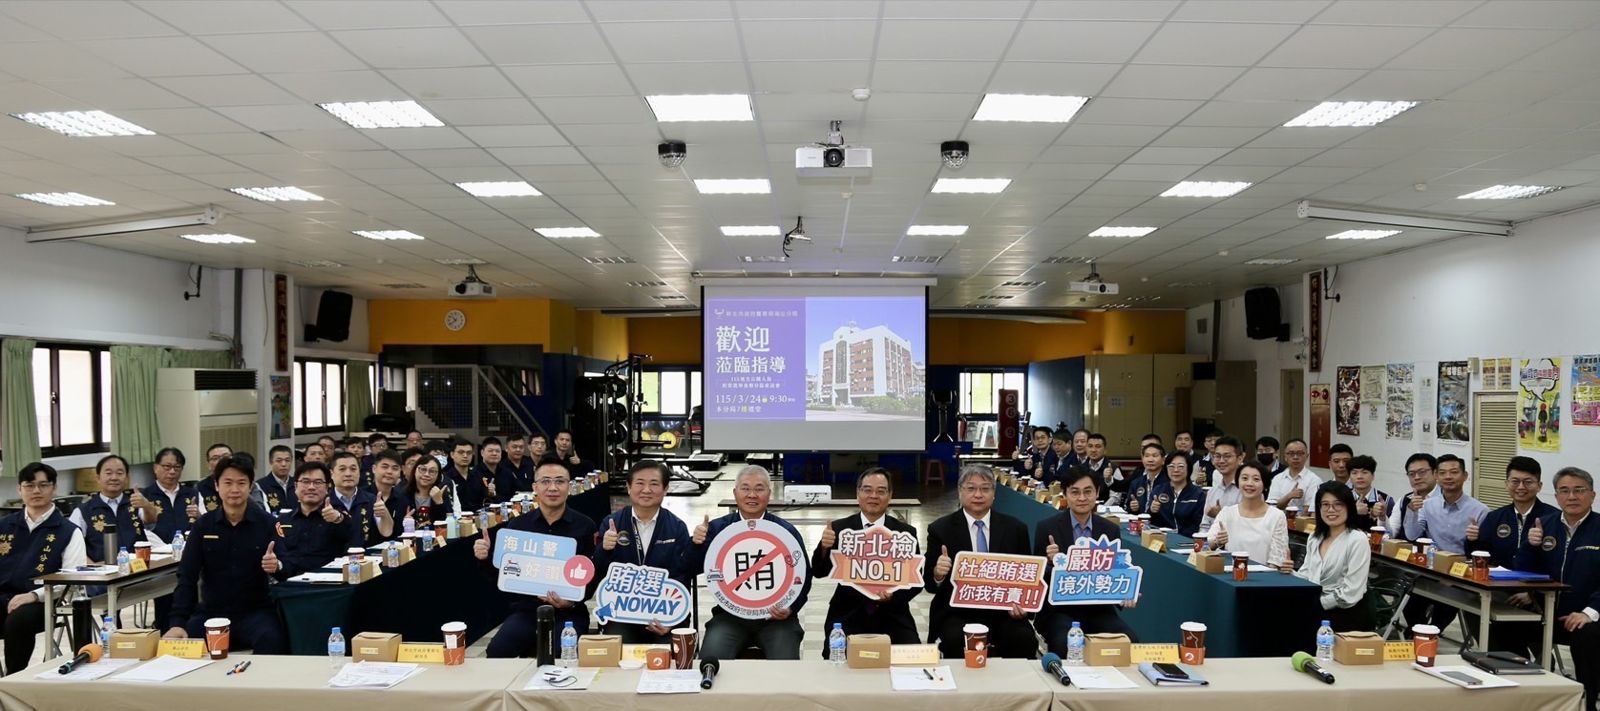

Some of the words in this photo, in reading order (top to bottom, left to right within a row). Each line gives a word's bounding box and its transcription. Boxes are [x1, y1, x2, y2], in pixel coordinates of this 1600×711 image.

[715, 325, 770, 352] 歡迎
[715, 356, 786, 373] 蒞臨指導
[716, 394, 761, 403] 115/3/24
[503, 535, 558, 557] 海山警
[841, 532, 914, 559] 新北檢
[735, 549, 775, 591] 賄
[850, 559, 904, 581] NO.1
[958, 559, 1039, 582] 杜絕賄選
[1066, 548, 1116, 572] 嚴防
[605, 566, 666, 596] 賄選
[1056, 574, 1131, 595] 境外勢力
[614, 595, 681, 616] NOWAY
